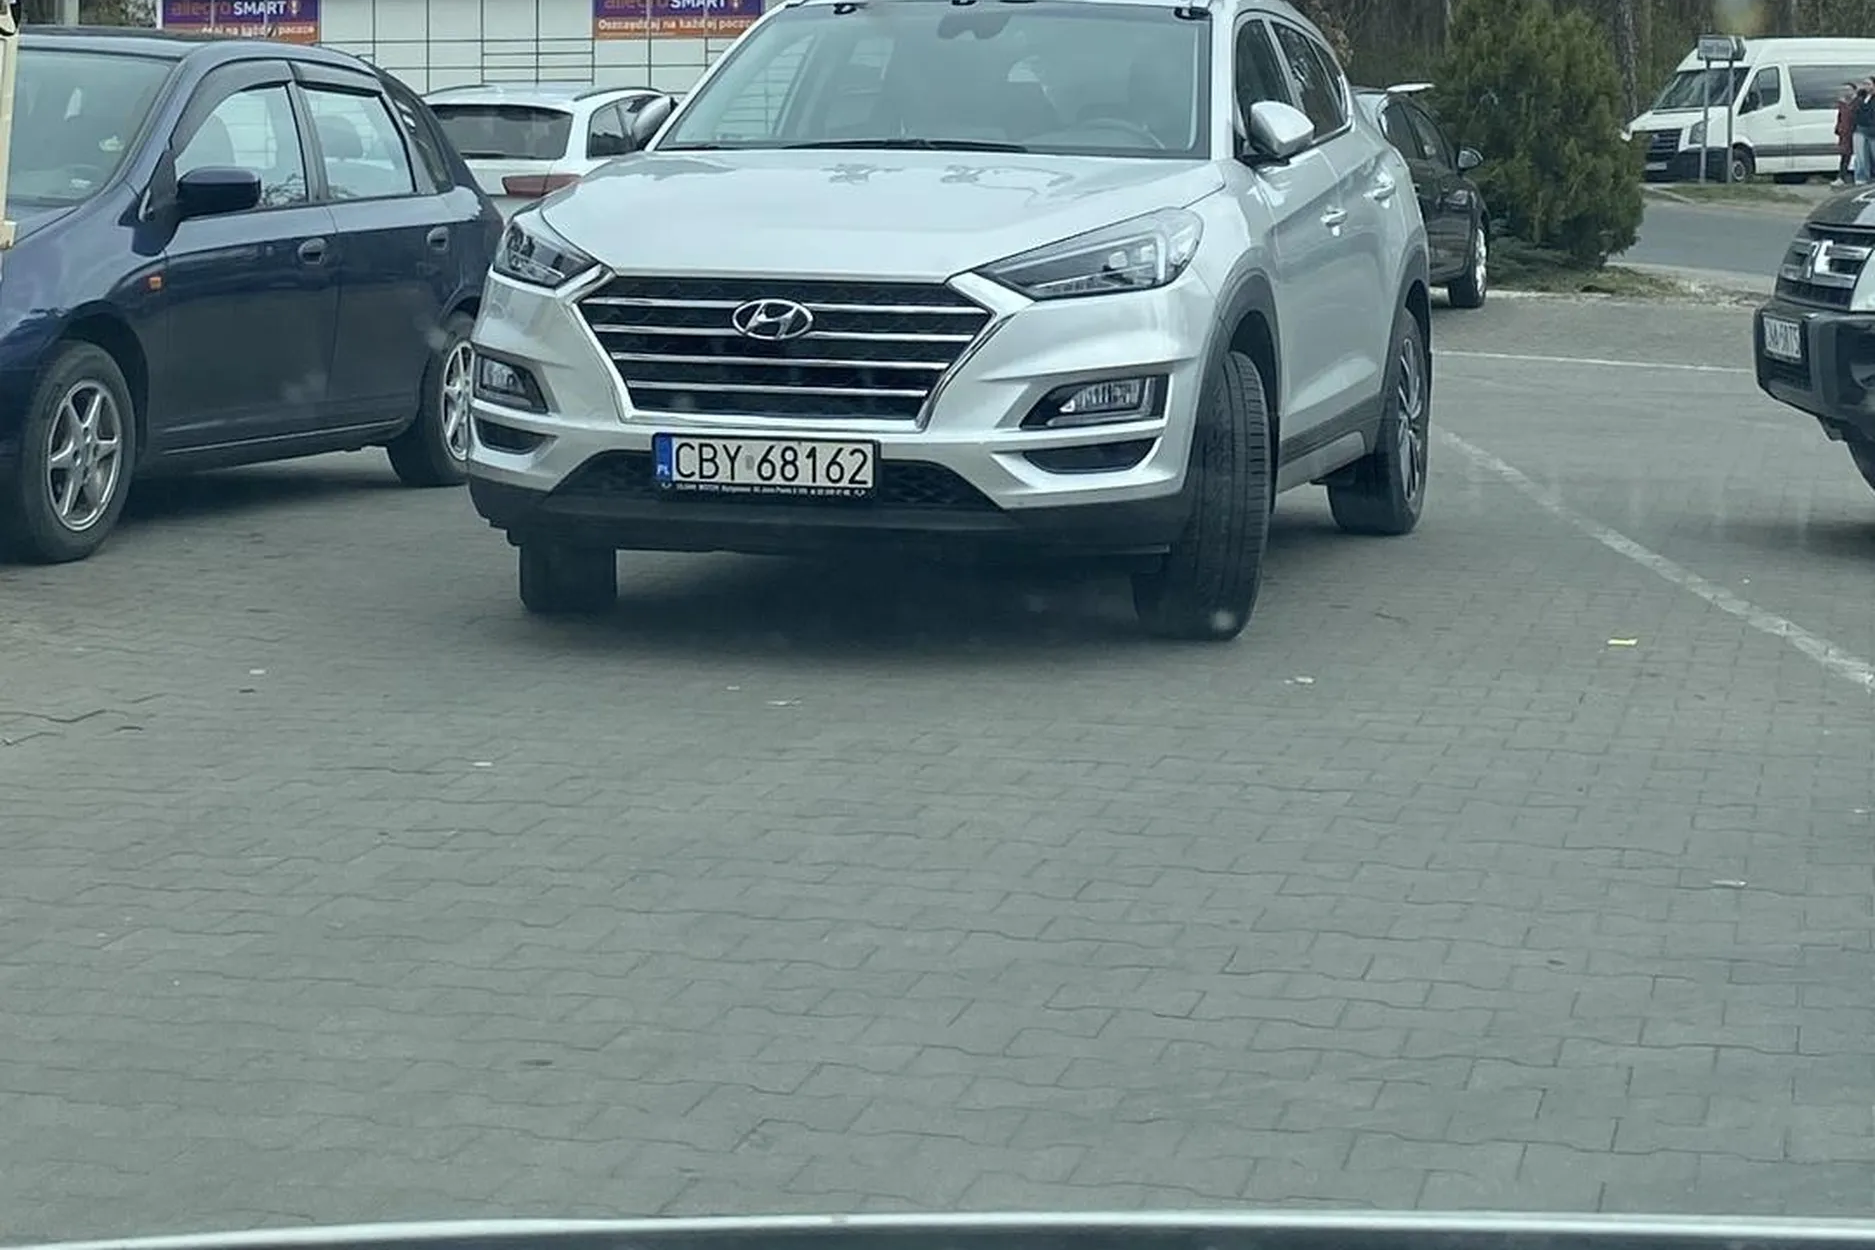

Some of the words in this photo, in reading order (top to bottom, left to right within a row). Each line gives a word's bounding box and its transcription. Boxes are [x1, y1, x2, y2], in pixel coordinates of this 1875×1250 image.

[171, 0, 231, 20] allegro
[663, 20, 676, 29] na
[656, 465, 670, 476] PL
[675, 442, 742, 481] CBY
[757, 445, 869, 485] 68162
